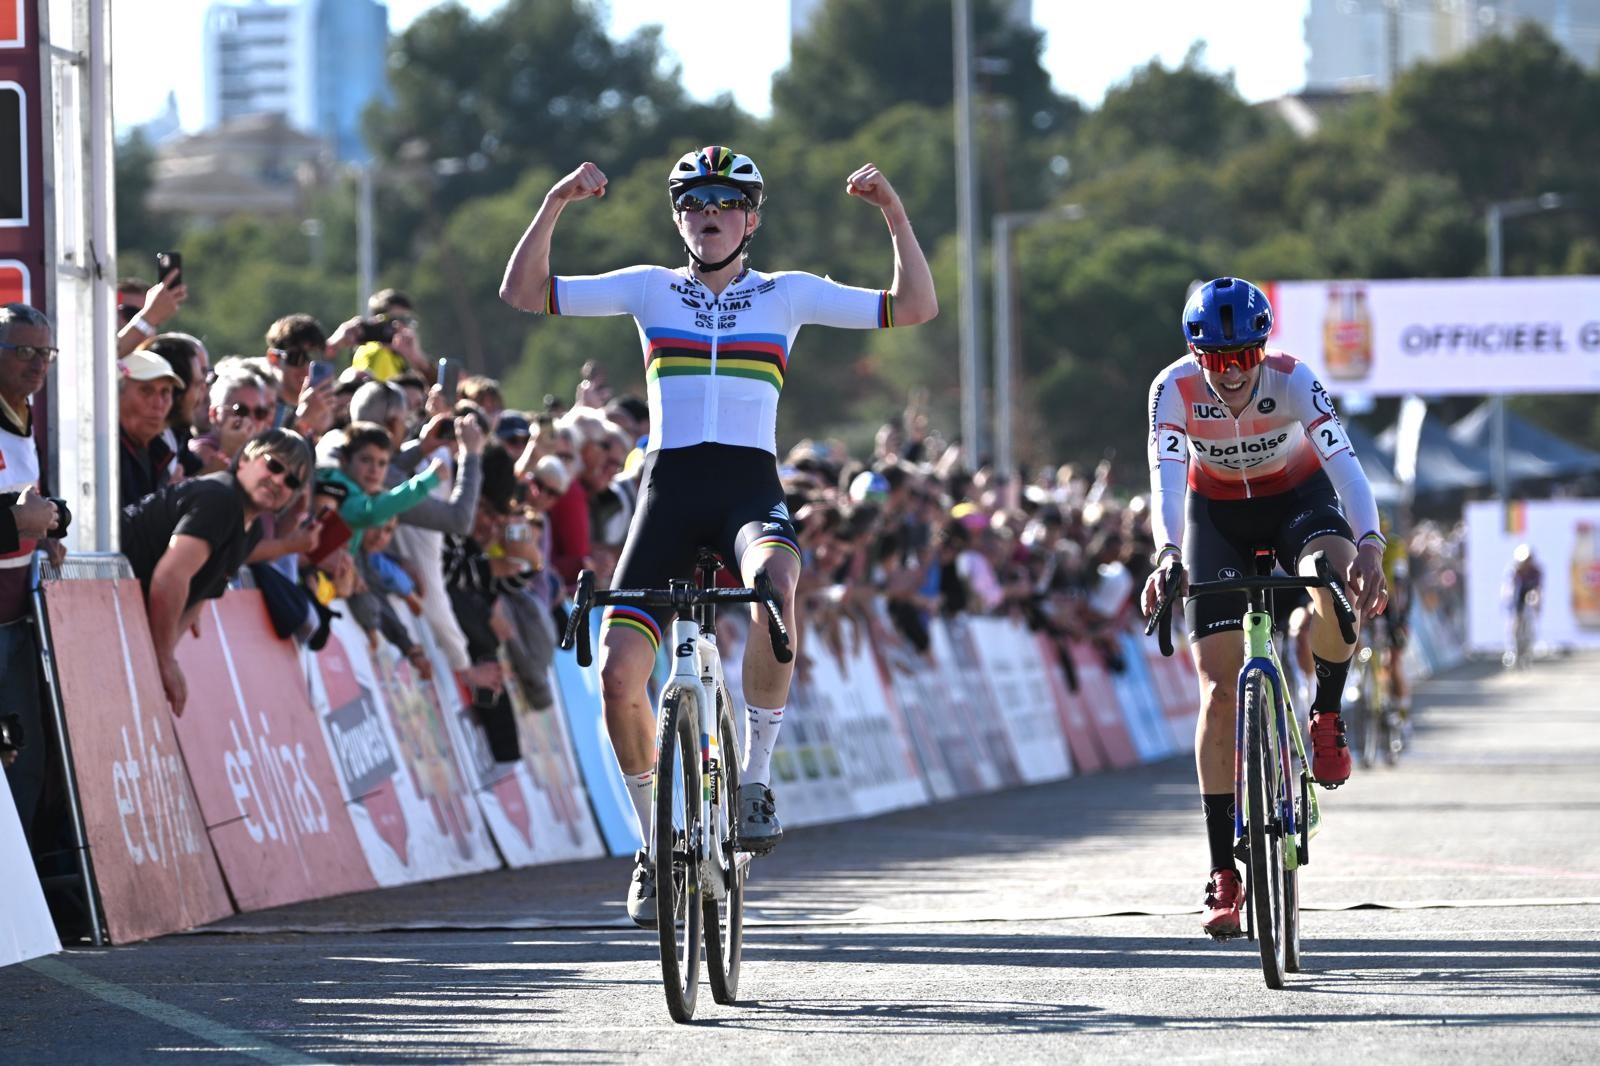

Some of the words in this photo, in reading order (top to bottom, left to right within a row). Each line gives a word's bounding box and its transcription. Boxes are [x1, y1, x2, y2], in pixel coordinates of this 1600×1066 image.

[676, 285, 706, 300] UCI
[705, 300, 752, 311] VISMA
[1401, 323, 1567, 355] OFFICIEEL
[1197, 404, 1227, 419] UCI
[1166, 435, 1179, 452] 2
[1210, 432, 1288, 457] baloise
[1321, 429, 1339, 447] 2
[1206, 619, 1241, 629] TREK
